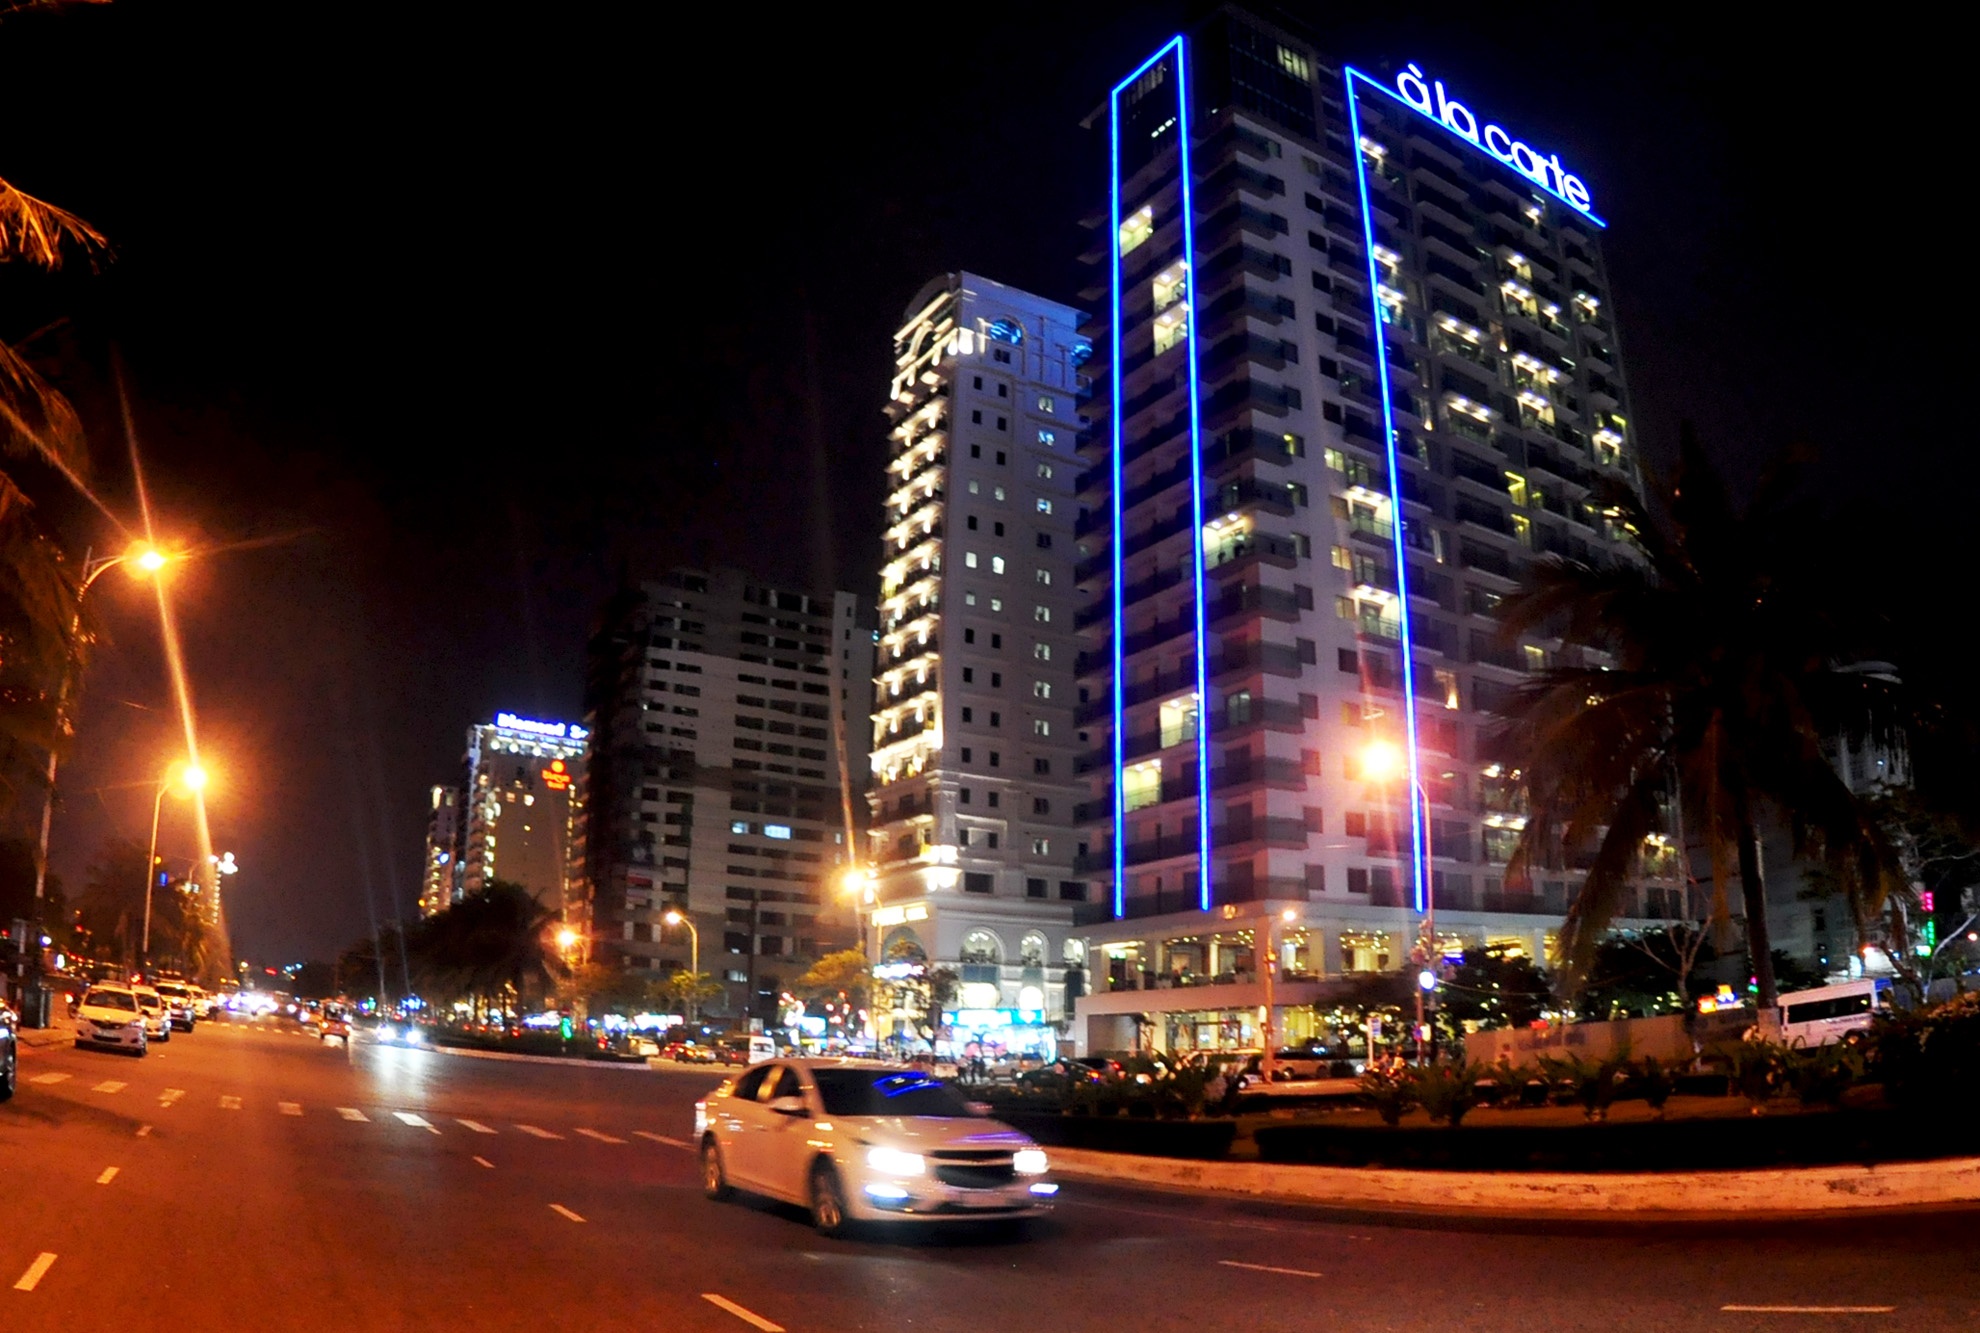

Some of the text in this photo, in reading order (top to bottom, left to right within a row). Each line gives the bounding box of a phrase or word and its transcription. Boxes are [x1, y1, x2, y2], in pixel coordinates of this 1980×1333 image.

[1397, 63, 1590, 212] à la carte
